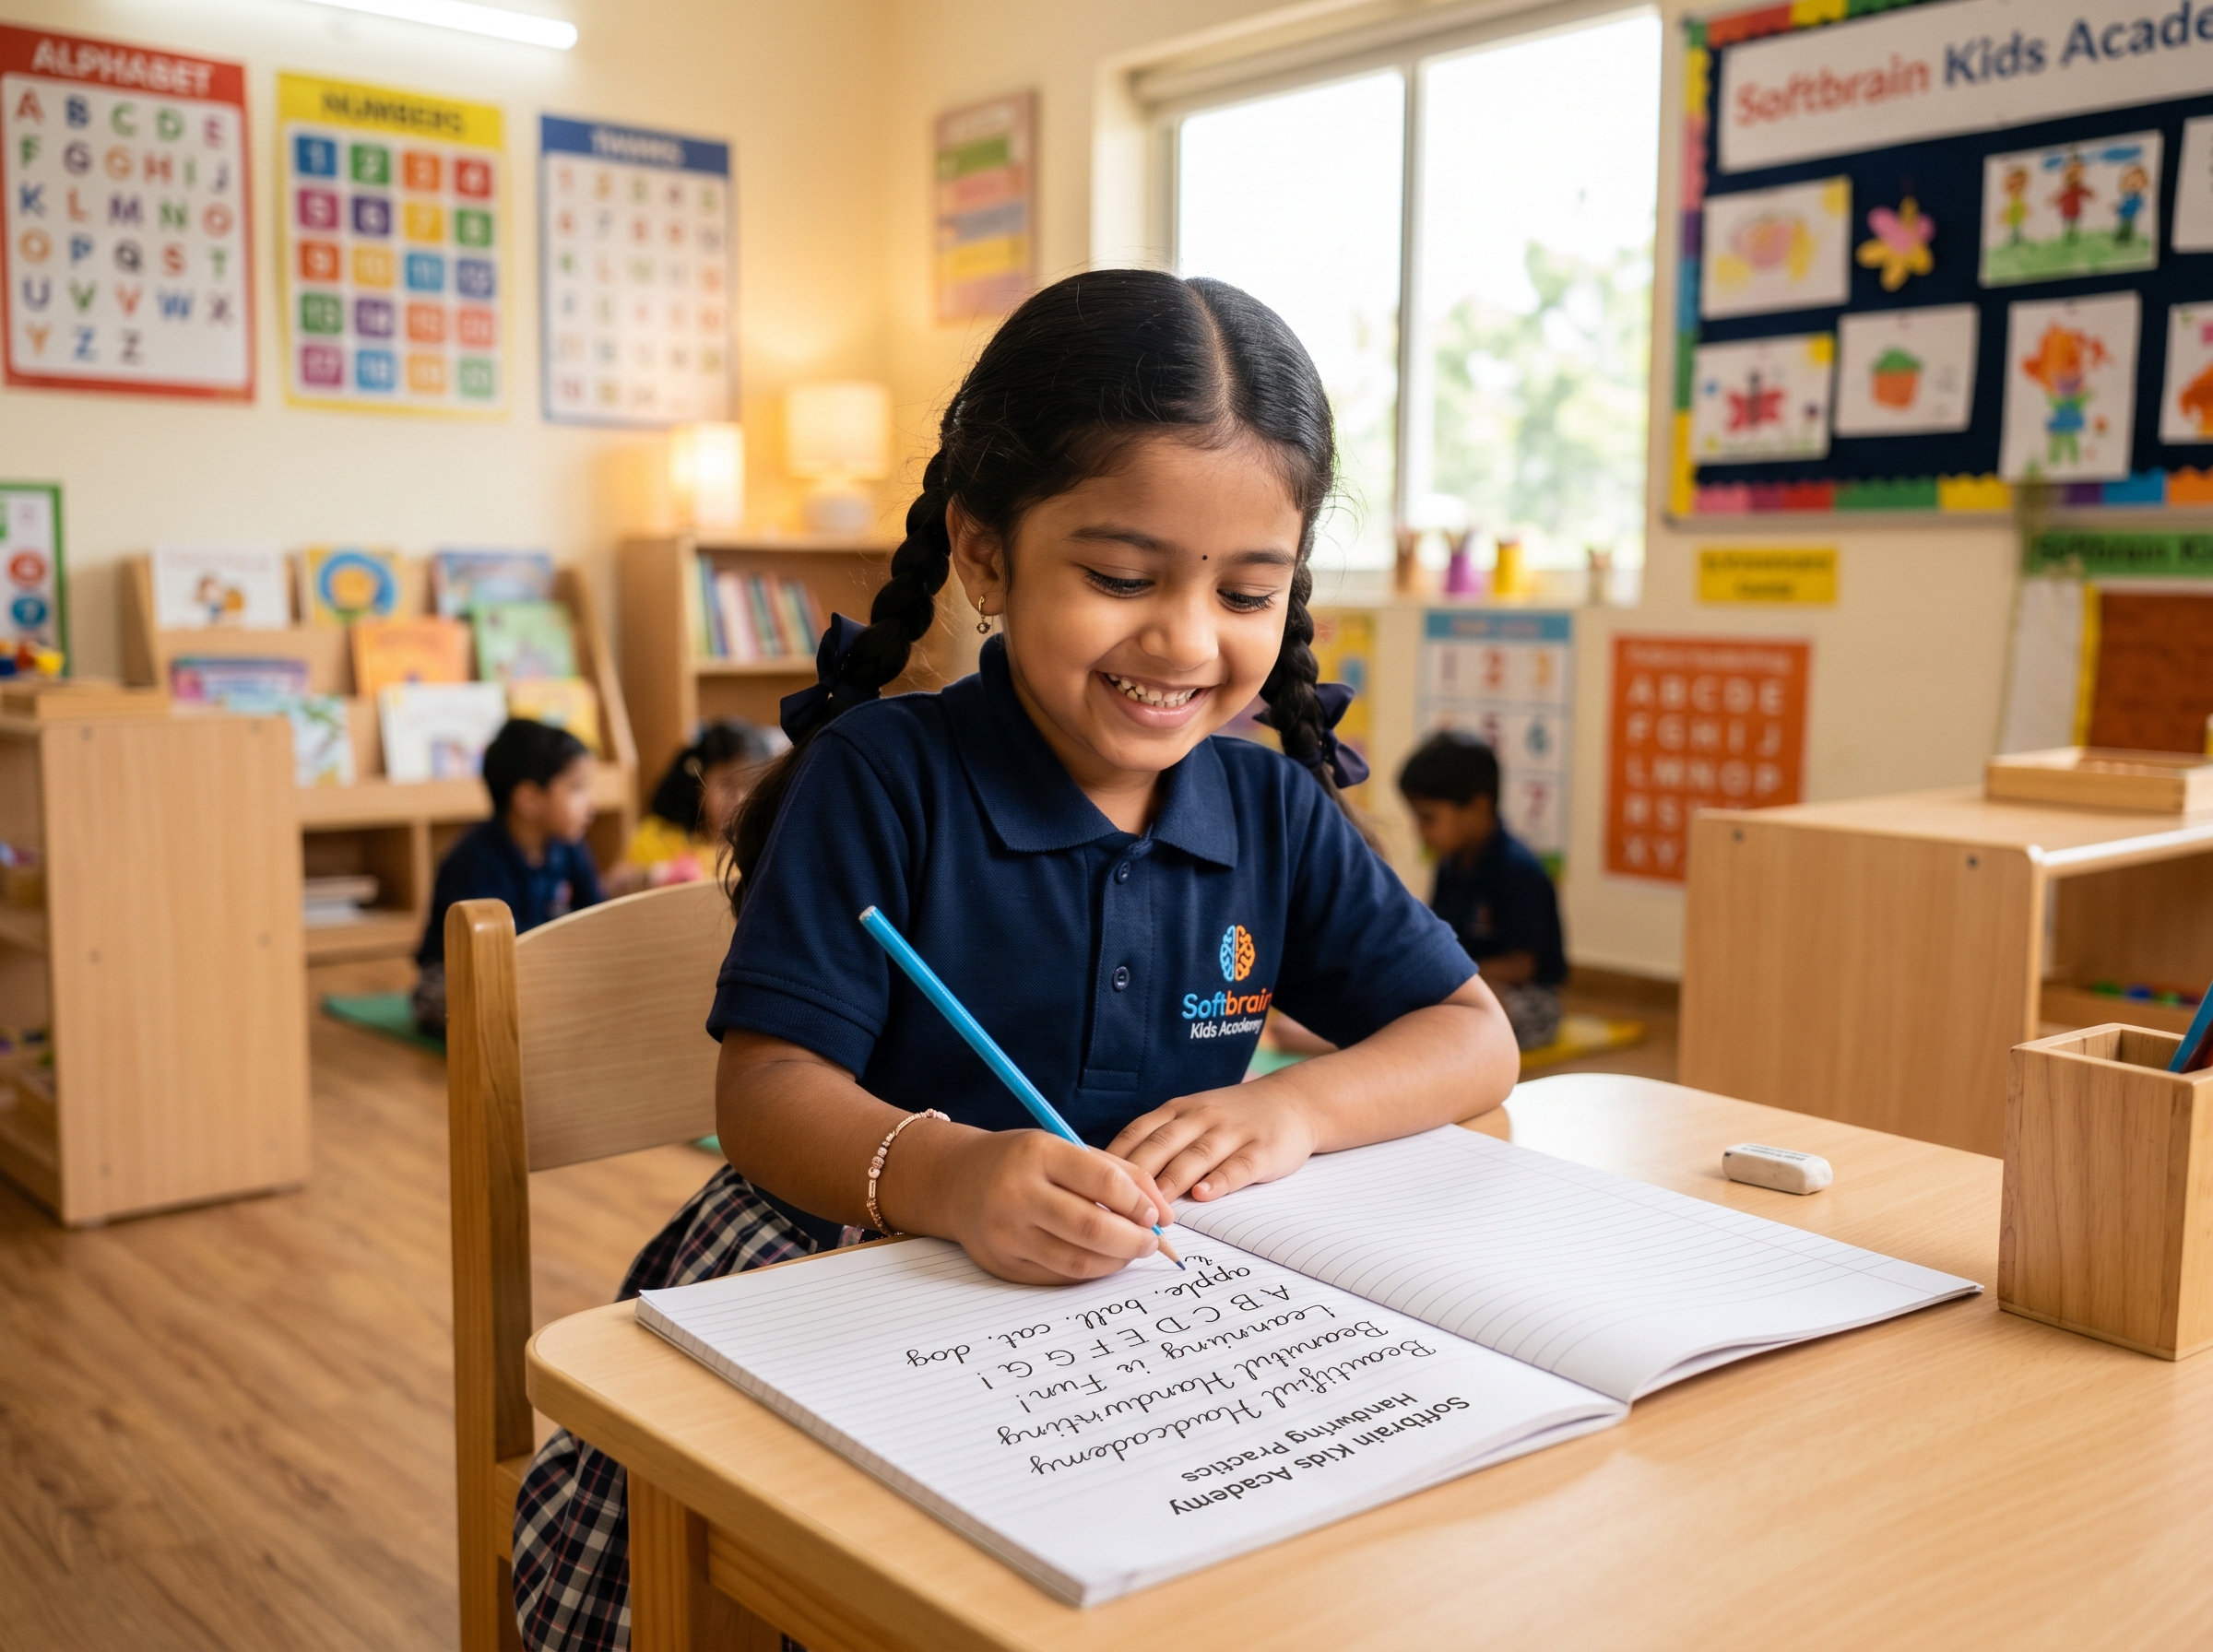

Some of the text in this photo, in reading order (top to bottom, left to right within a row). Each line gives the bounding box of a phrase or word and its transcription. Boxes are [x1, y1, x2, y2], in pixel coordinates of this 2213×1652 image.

[32, 38, 215, 97] ALPHABET
[1734, 52, 1933, 127] Softbrain
[1943, 30, 2047, 88] Kids
[16, 88, 225, 150] A B C D E
[321, 93, 465, 136] NUMBERS
[20, 134, 39, 170] F
[63, 141, 91, 178] G
[144, 151, 174, 187] H
[212, 160, 231, 195] J
[19, 182, 234, 238] K L M N O
[18, 228, 227, 282] O P Q S T
[23, 276, 51, 312] U
[69, 279, 96, 313] V
[157, 288, 195, 322] W
[72, 325, 96, 361] Z
[1626, 673, 1785, 717] A B C D E
[1755, 720, 1783, 758] J
[1719, 759, 1752, 797] O
[1190, 1021, 1217, 1039] Kids
[1230, 1293, 1264, 1312] B
[1260, 1284, 1290, 1301] A
[1155, 1316, 1191, 1334] D
[1192, 1306, 1221, 1323] C
[905, 1344, 971, 1367] dog
[1090, 1339, 1115, 1359] F
[1117, 1328, 1150, 1348] E
[997, 1361, 1033, 1378] G
[1045, 1350, 1075, 1367] G
[1015, 1374, 1107, 1413] Fun!
[1169, 1397, 1470, 1516] Softbrain Kids Academy
[1181, 1441, 1291, 1482] Practics
